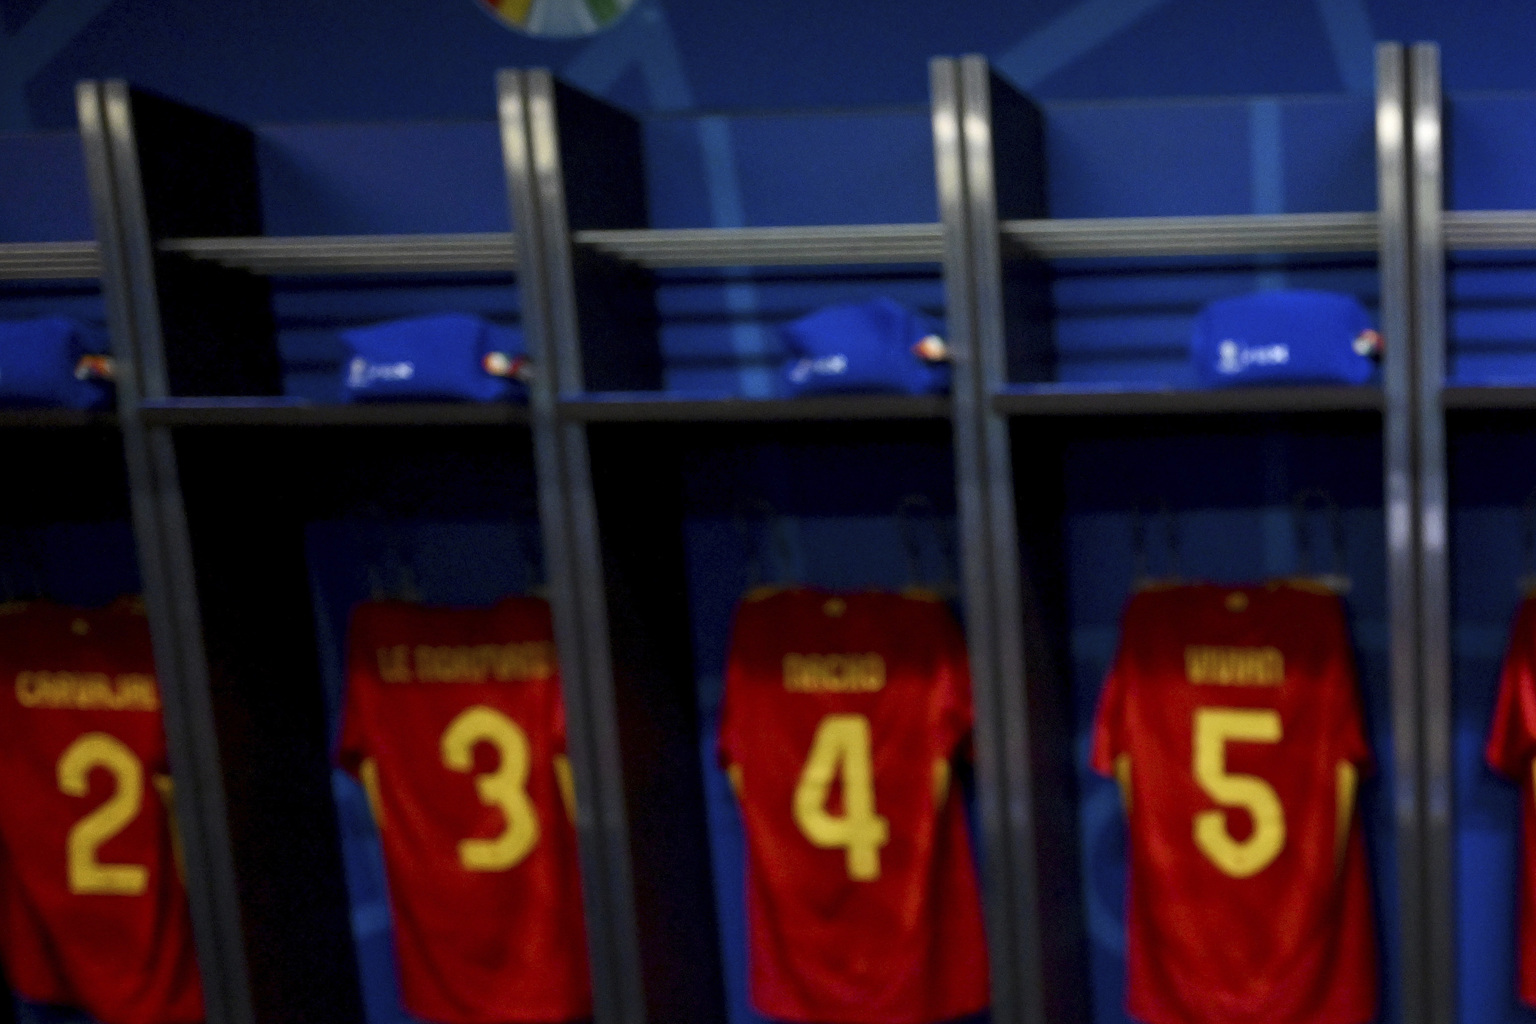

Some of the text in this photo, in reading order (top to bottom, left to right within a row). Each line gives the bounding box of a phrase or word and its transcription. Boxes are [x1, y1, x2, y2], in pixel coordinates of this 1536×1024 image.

[60, 736, 146, 893] 2
[443, 708, 537, 870] 3
[794, 716, 887, 880] 4
[1194, 709, 1285, 877] 5
